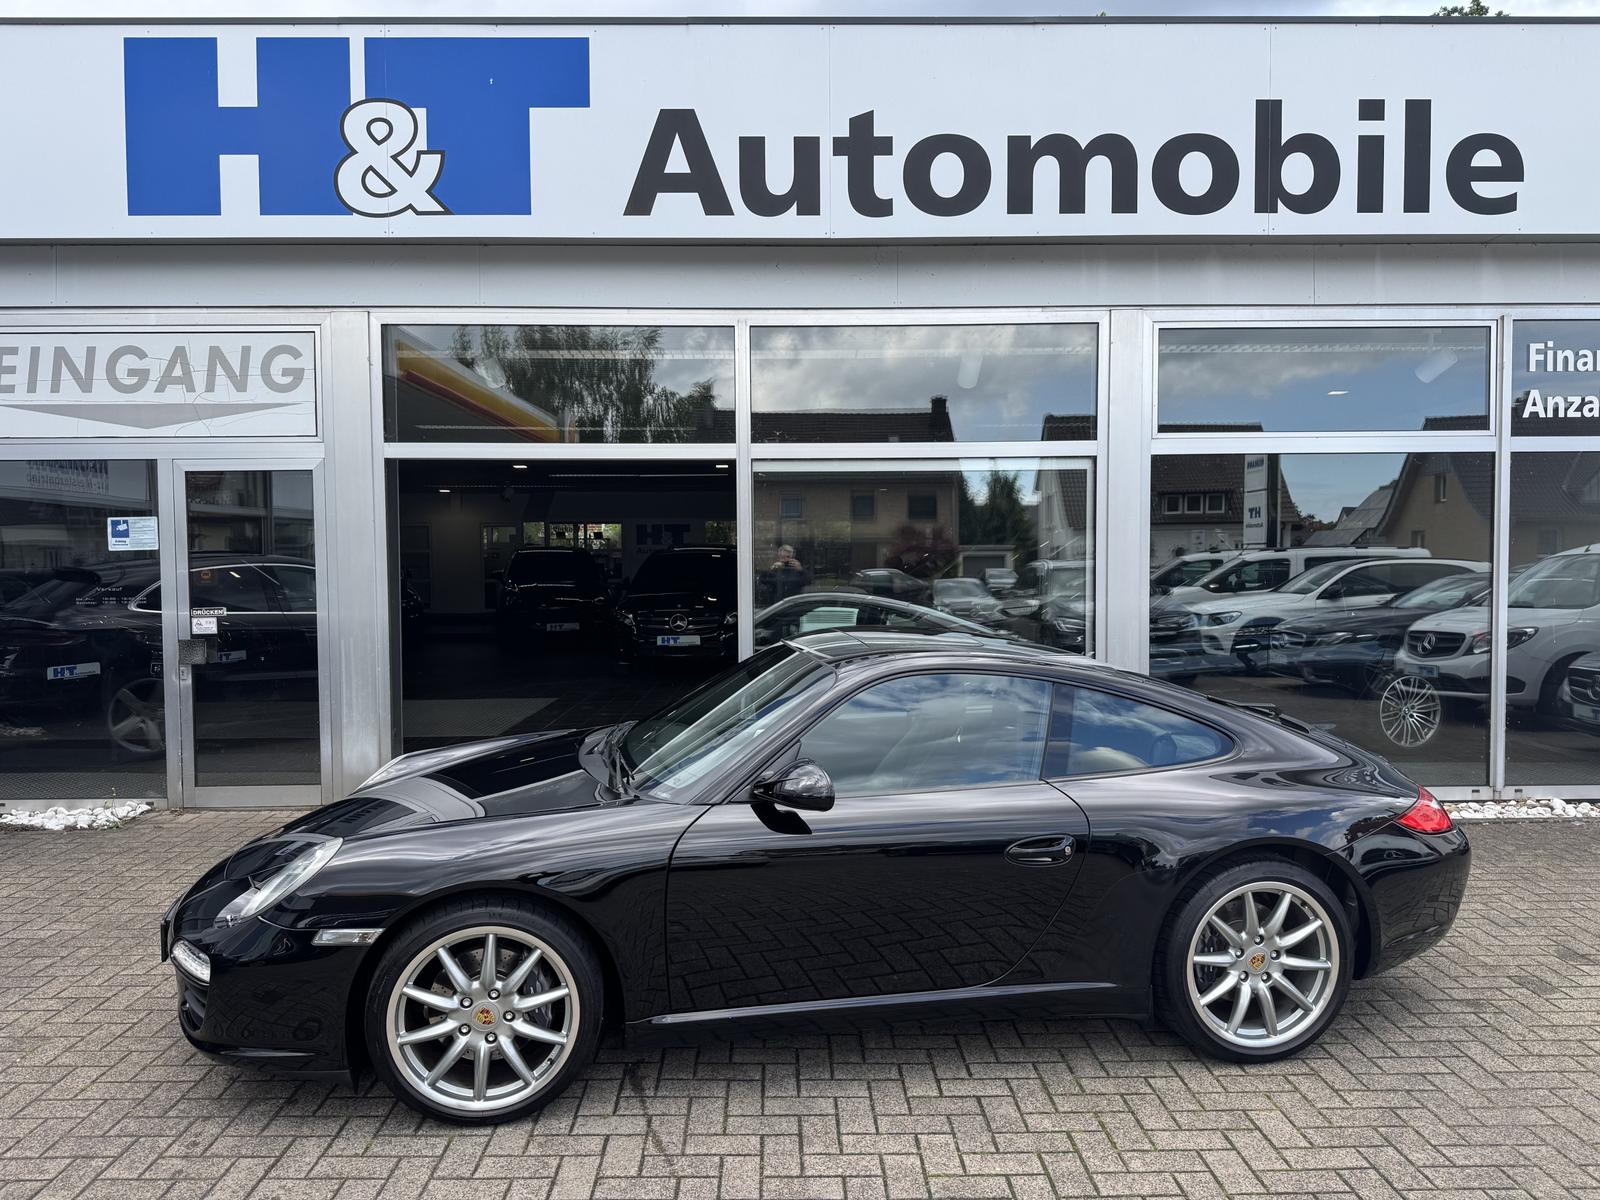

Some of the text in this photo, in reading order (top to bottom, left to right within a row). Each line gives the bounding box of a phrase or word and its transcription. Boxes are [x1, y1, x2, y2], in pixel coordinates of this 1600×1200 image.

[123, 37, 1525, 218] H&T Automobile
[0, 344, 306, 395] EINGANG
[1529, 340, 1600, 372] Fina
[1522, 389, 1600, 418] Anza
[192, 608, 224, 616] DRÜCKEN
